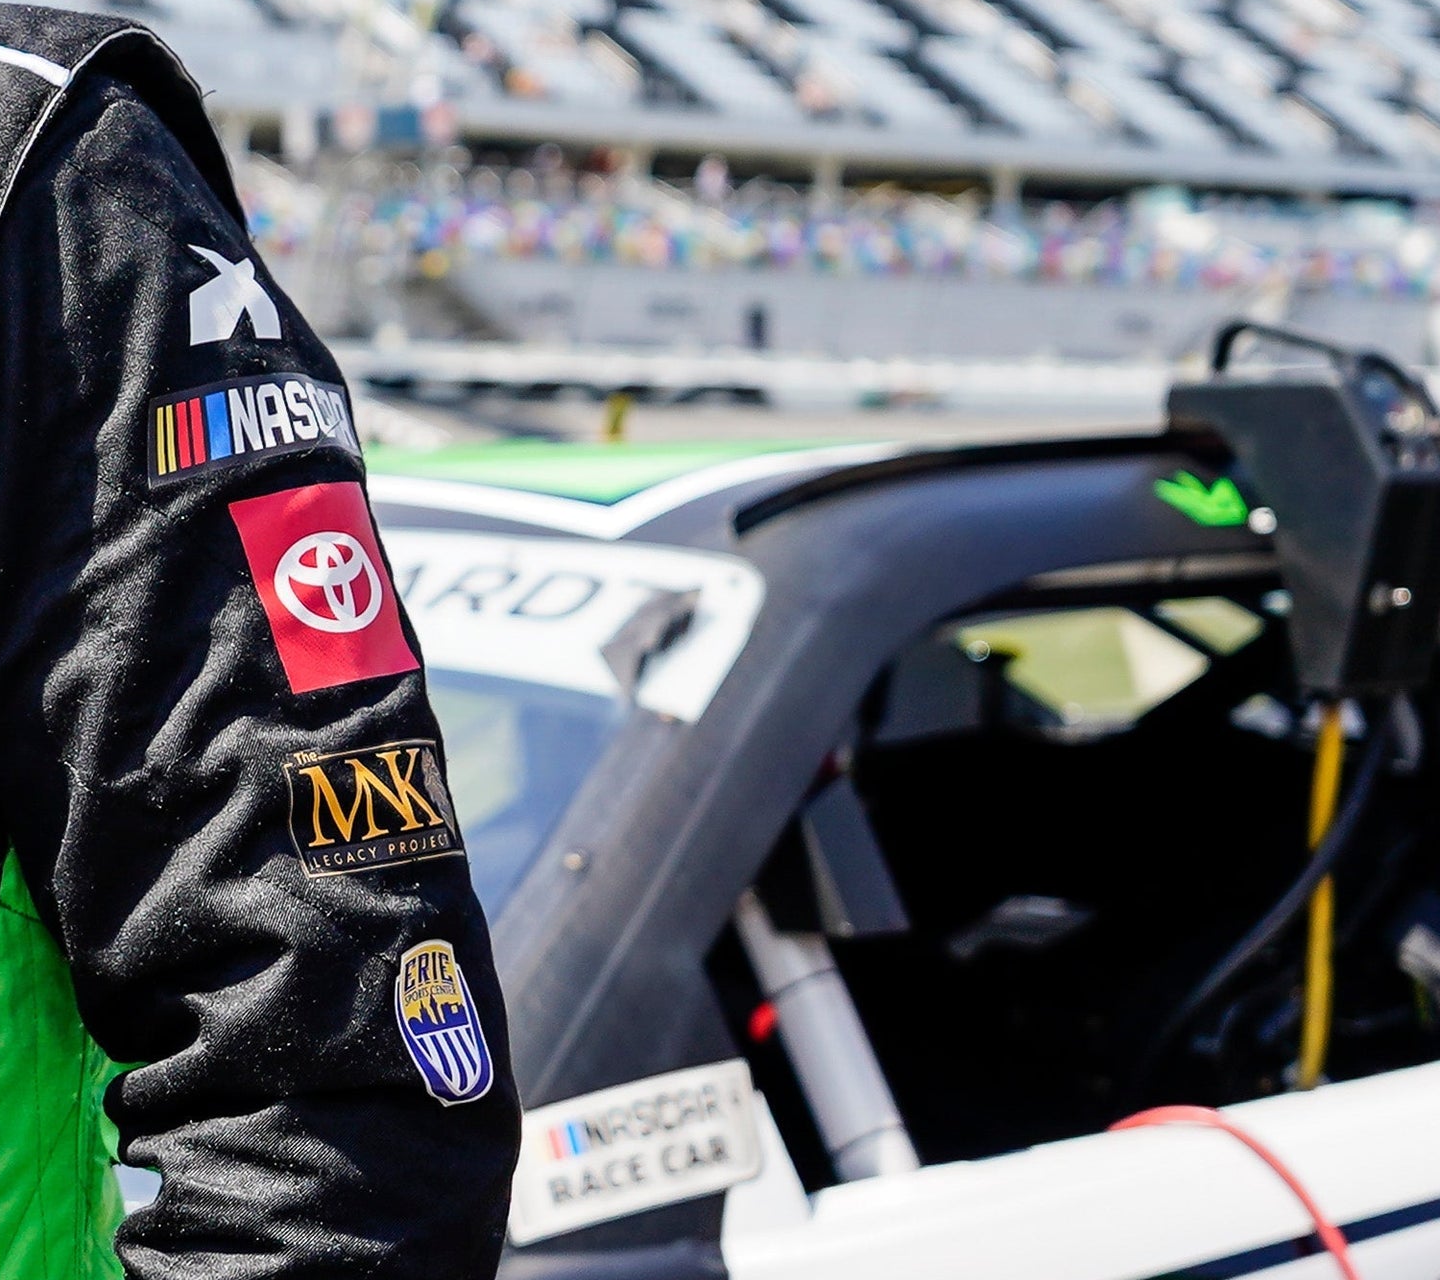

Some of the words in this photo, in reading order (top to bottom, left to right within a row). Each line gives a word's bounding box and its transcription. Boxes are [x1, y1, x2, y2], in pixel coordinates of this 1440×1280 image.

[294, 750, 319, 765] The
[309, 846, 377, 871] LEGACY
[387, 833, 449, 856] PROJECT
[404, 951, 453, 992] ERIE
[548, 1152, 646, 1204] RACE
[660, 1134, 729, 1176] CAR
